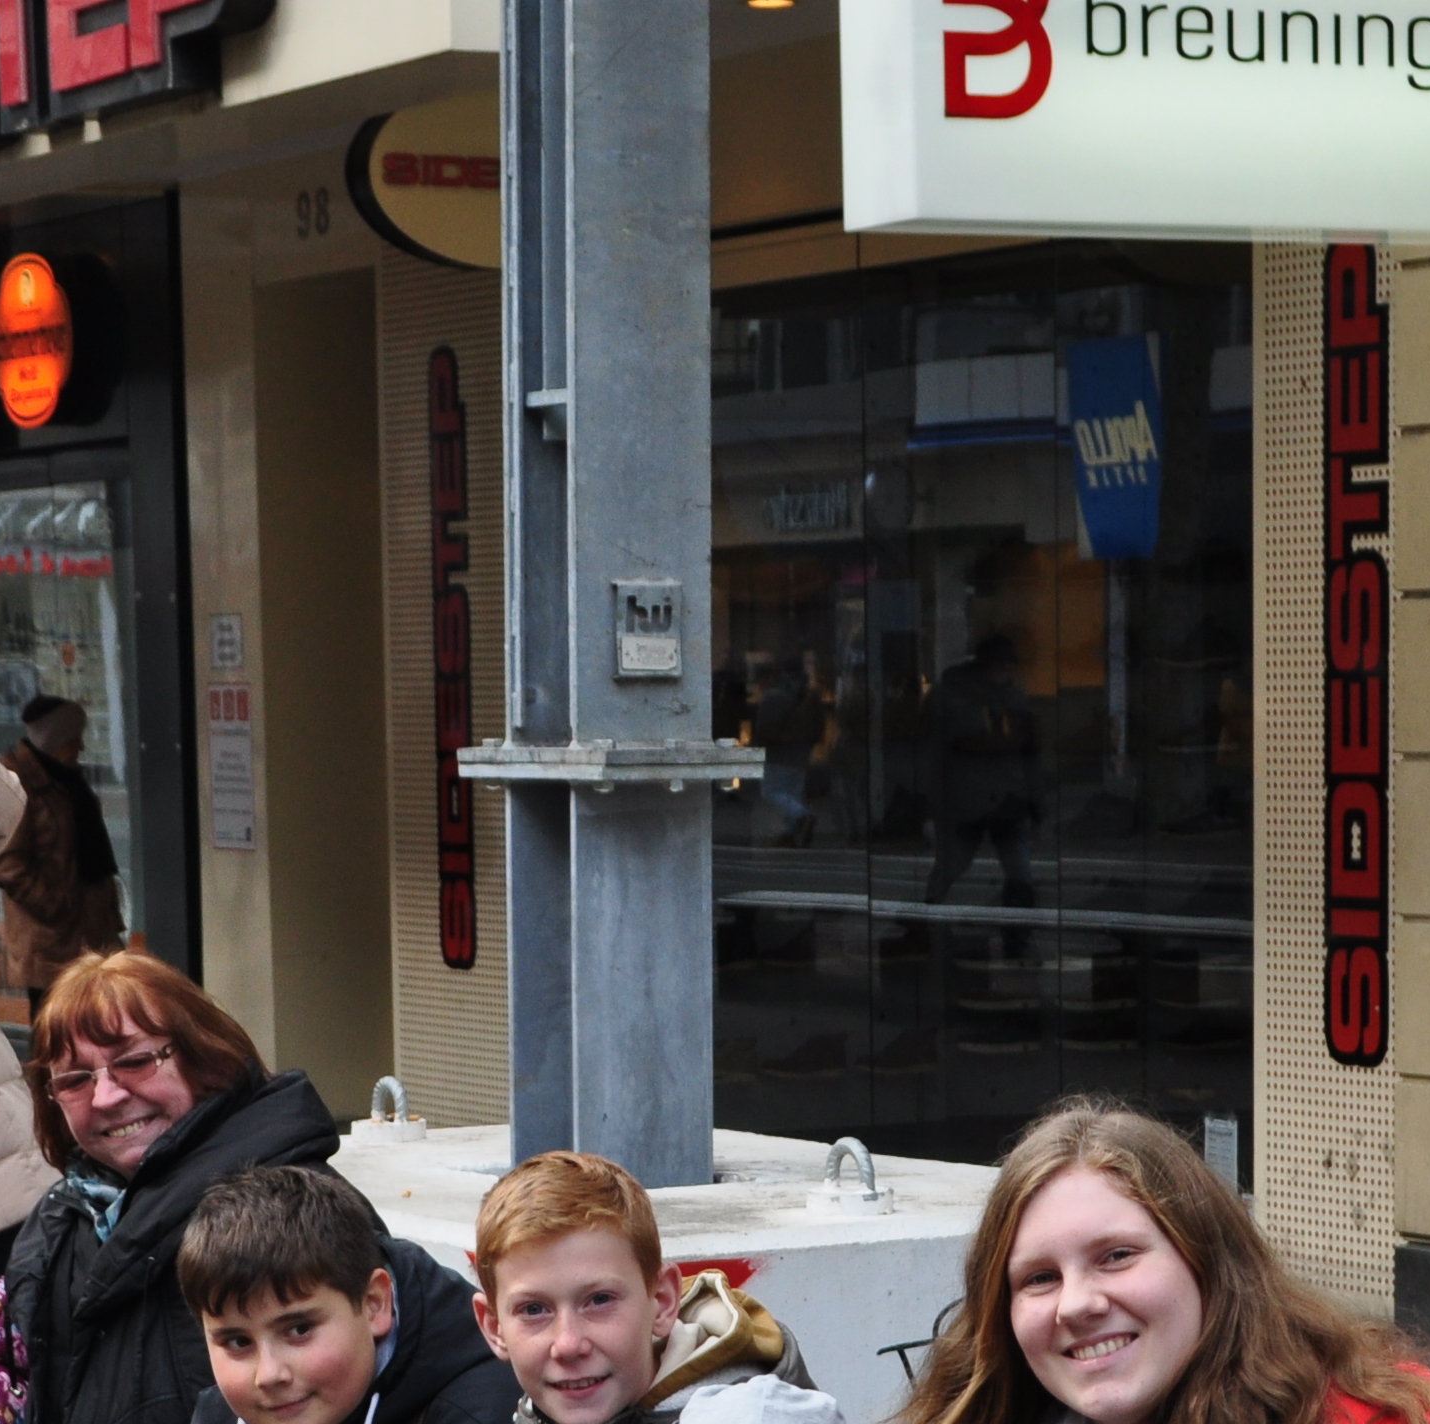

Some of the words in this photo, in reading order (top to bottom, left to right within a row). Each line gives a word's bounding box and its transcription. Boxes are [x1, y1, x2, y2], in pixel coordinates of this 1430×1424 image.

[296, 186, 331, 241] 98
[429, 345, 476, 970] SIDESTEP
[1325, 232, 1389, 1067] SIDESTEP
